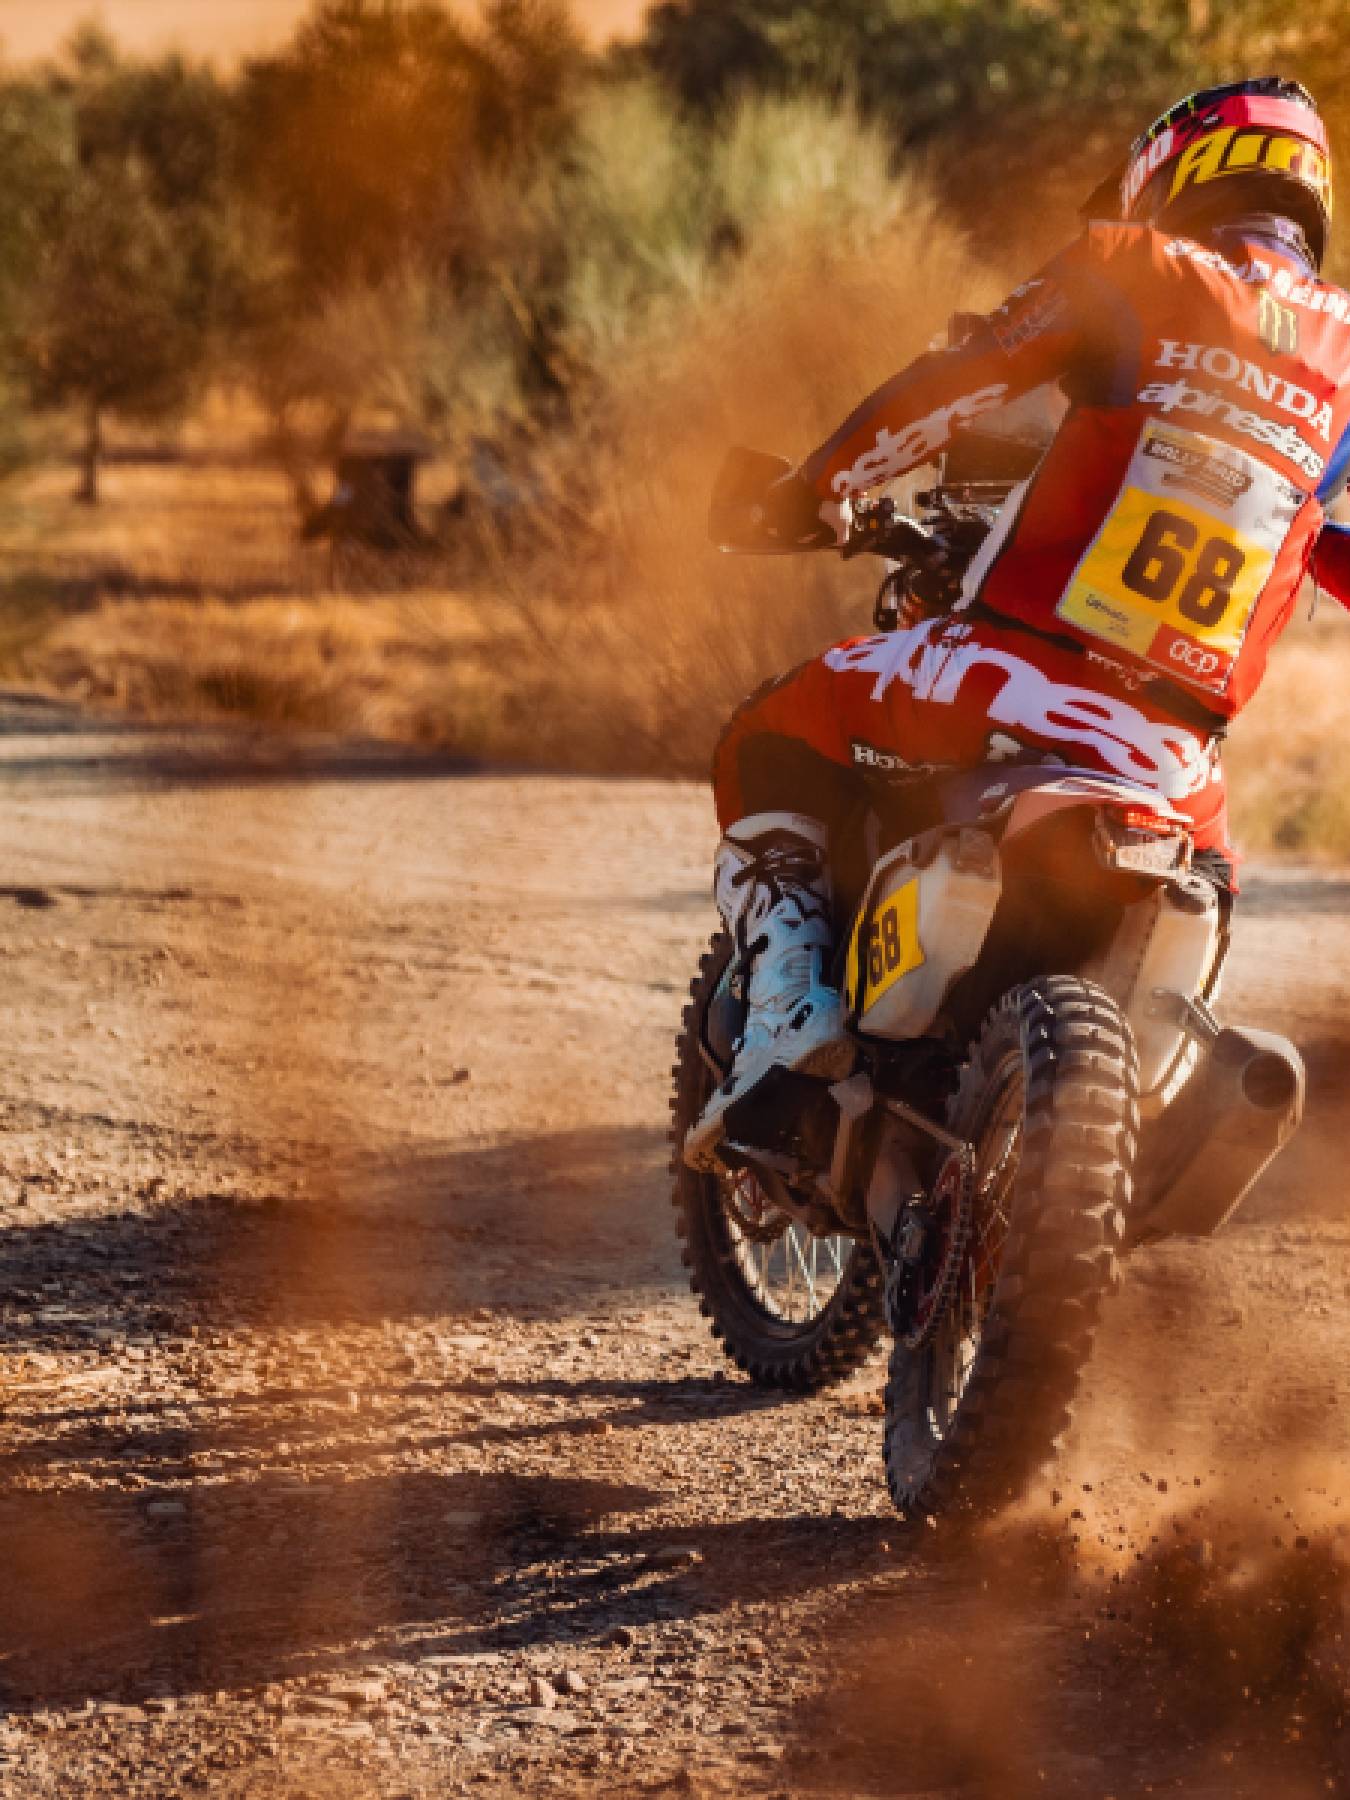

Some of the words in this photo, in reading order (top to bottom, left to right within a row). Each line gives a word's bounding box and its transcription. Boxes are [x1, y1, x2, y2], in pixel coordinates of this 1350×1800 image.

[1154, 338, 1333, 442] HONDA
[1121, 509, 1246, 627] 68
[866, 905, 900, 988] 68
